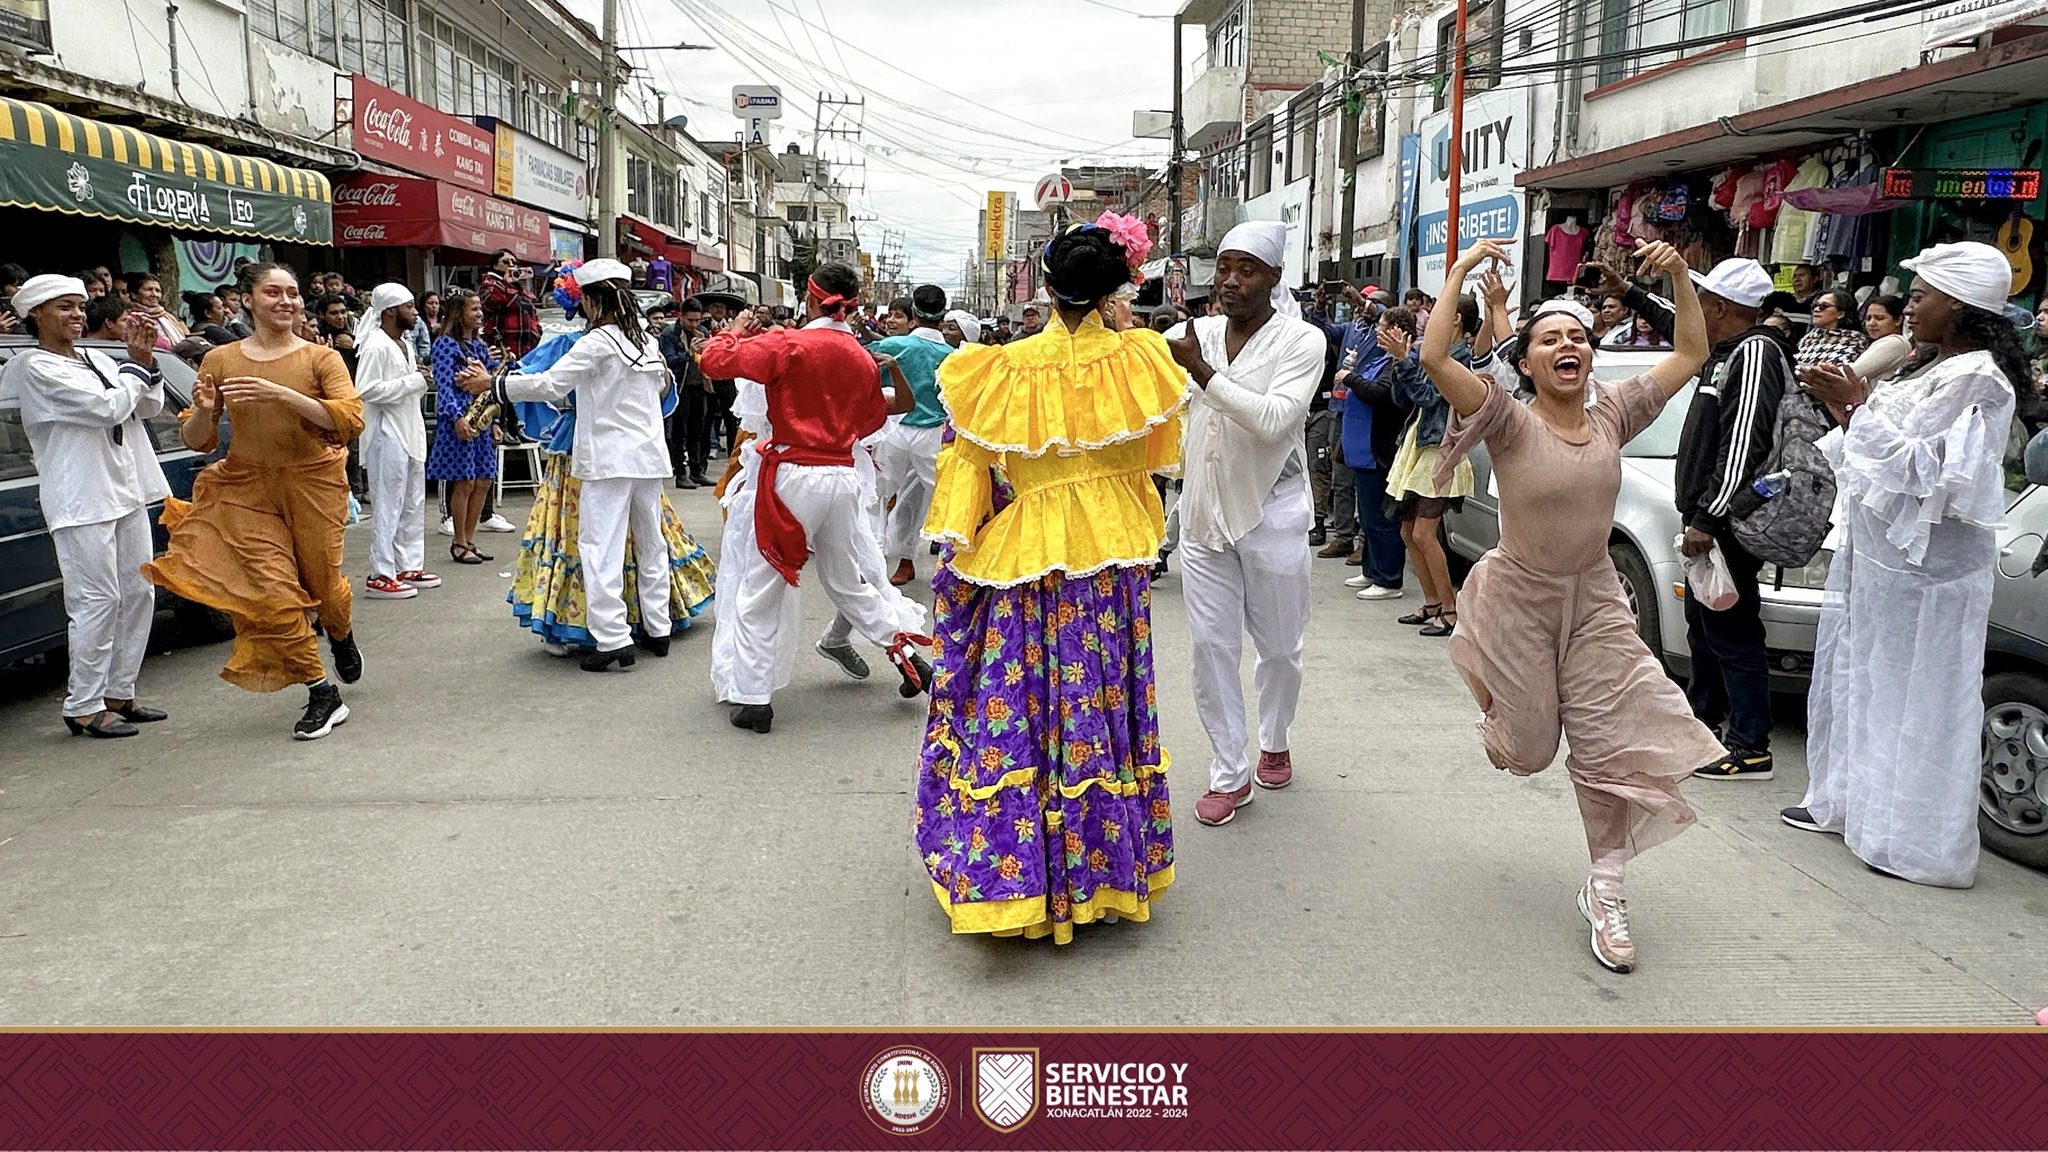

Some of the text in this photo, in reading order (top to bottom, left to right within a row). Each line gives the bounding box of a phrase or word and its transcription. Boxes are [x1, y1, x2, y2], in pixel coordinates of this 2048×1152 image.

[364, 99, 412, 148] Coca-Cola
[449, 128, 491, 156] COMIDA CHINA
[1438, 116, 1513, 182] UNITY
[456, 155, 484, 175] KANG TAI
[332, 183, 398, 206] Coca-Cola
[452, 191, 475, 219] Coca-Cola
[344, 225, 385, 239] Coca-Cola
[486, 211, 515, 233] KANG TAI
[991, 197, 1002, 240] elektra
[1425, 206, 1512, 252] ¡INSRÍBETE!
